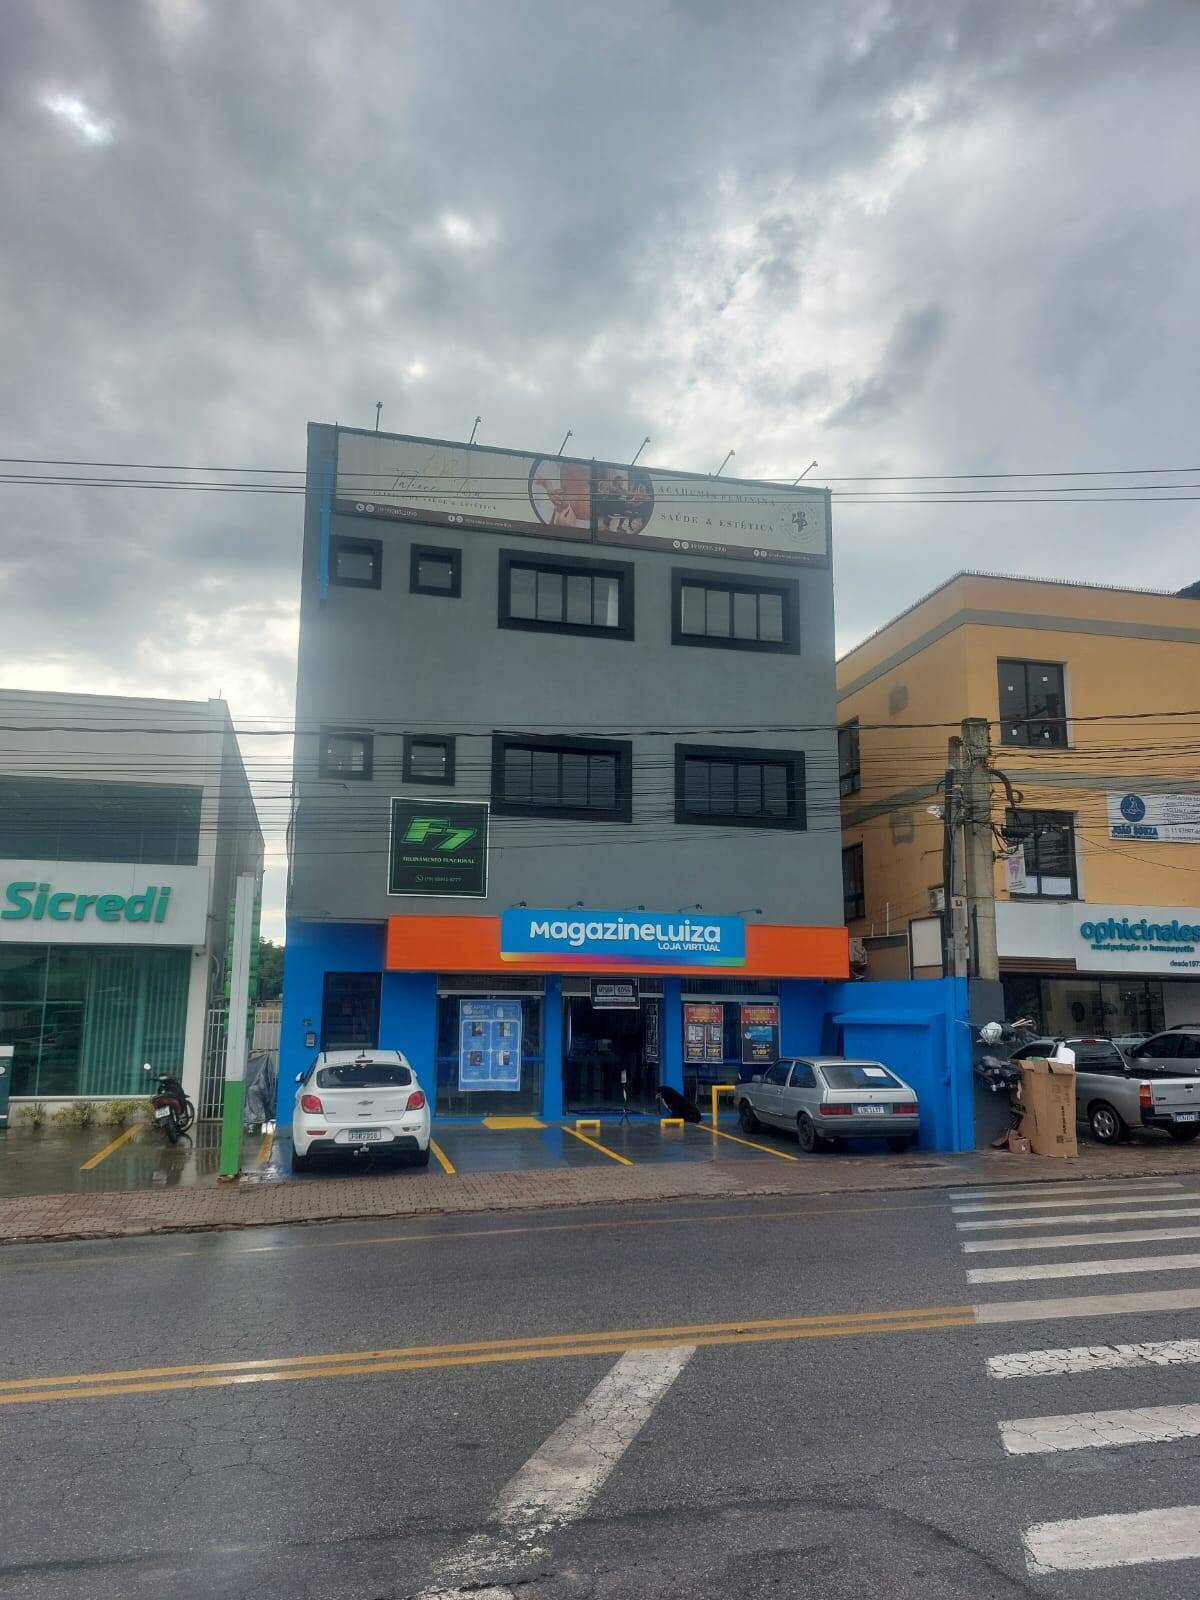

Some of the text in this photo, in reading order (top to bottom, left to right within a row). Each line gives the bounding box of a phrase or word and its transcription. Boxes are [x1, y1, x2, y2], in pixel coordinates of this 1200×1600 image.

[659, 511, 774, 533] SAÚDE & ESTÉTICA
[1, 881, 172, 923] Sicredi
[657, 942, 721, 952] LOJA VIRTUAL
